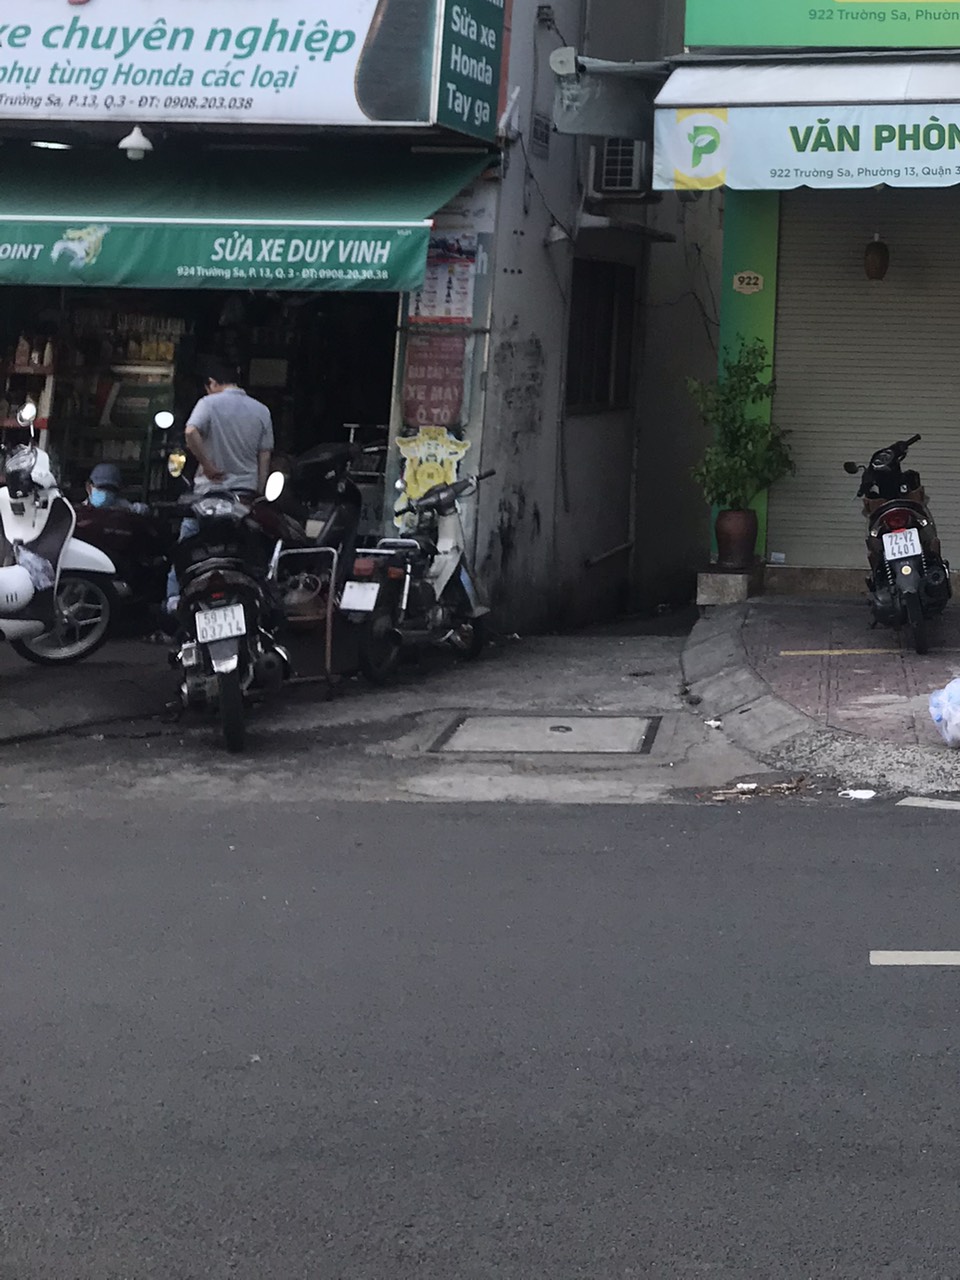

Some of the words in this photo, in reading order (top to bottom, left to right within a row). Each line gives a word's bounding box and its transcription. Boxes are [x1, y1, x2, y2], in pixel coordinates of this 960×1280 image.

[451, 4, 477, 41] Sửa
[481, 24, 496, 51] xe
[809, 9, 834, 22] 922
[837, 6, 888, 24] Trường
[891, 9, 911, 23] Sa,
[42, 16, 194, 59] chuyên
[204, 18, 356, 61] nghiệp
[48, 58, 108, 90] tùng
[112, 62, 194, 88] Honda
[201, 60, 244, 88] các
[249, 63, 299, 94] loại
[450, 44, 493, 86] Honda
[104, 95, 125, 110] Q.3
[138, 95, 160, 109] ĐT:
[163, 96, 253, 110] 0908.203.038
[447, 82, 471, 122] Tay
[475, 98, 490, 127] ga
[789, 118, 861, 153] VĂN
[770, 169, 791, 179] 922
[794, 166, 834, 181] Trường
[837, 168, 854, 179] Sa,
[857, 165, 902, 180] Phường
[904, 167, 918, 178] 13,
[922, 165, 953, 179] Quận
[211, 231, 253, 262] SỬA
[256, 239, 285, 262] XE
[287, 239, 334, 263] DUY
[338, 240, 391, 264] VINH
[288, 268, 294, 278] 3
[737, 275, 759, 286] 922
[888, 531, 914, 546] 72-V2
[891, 543, 916, 558] 4401
